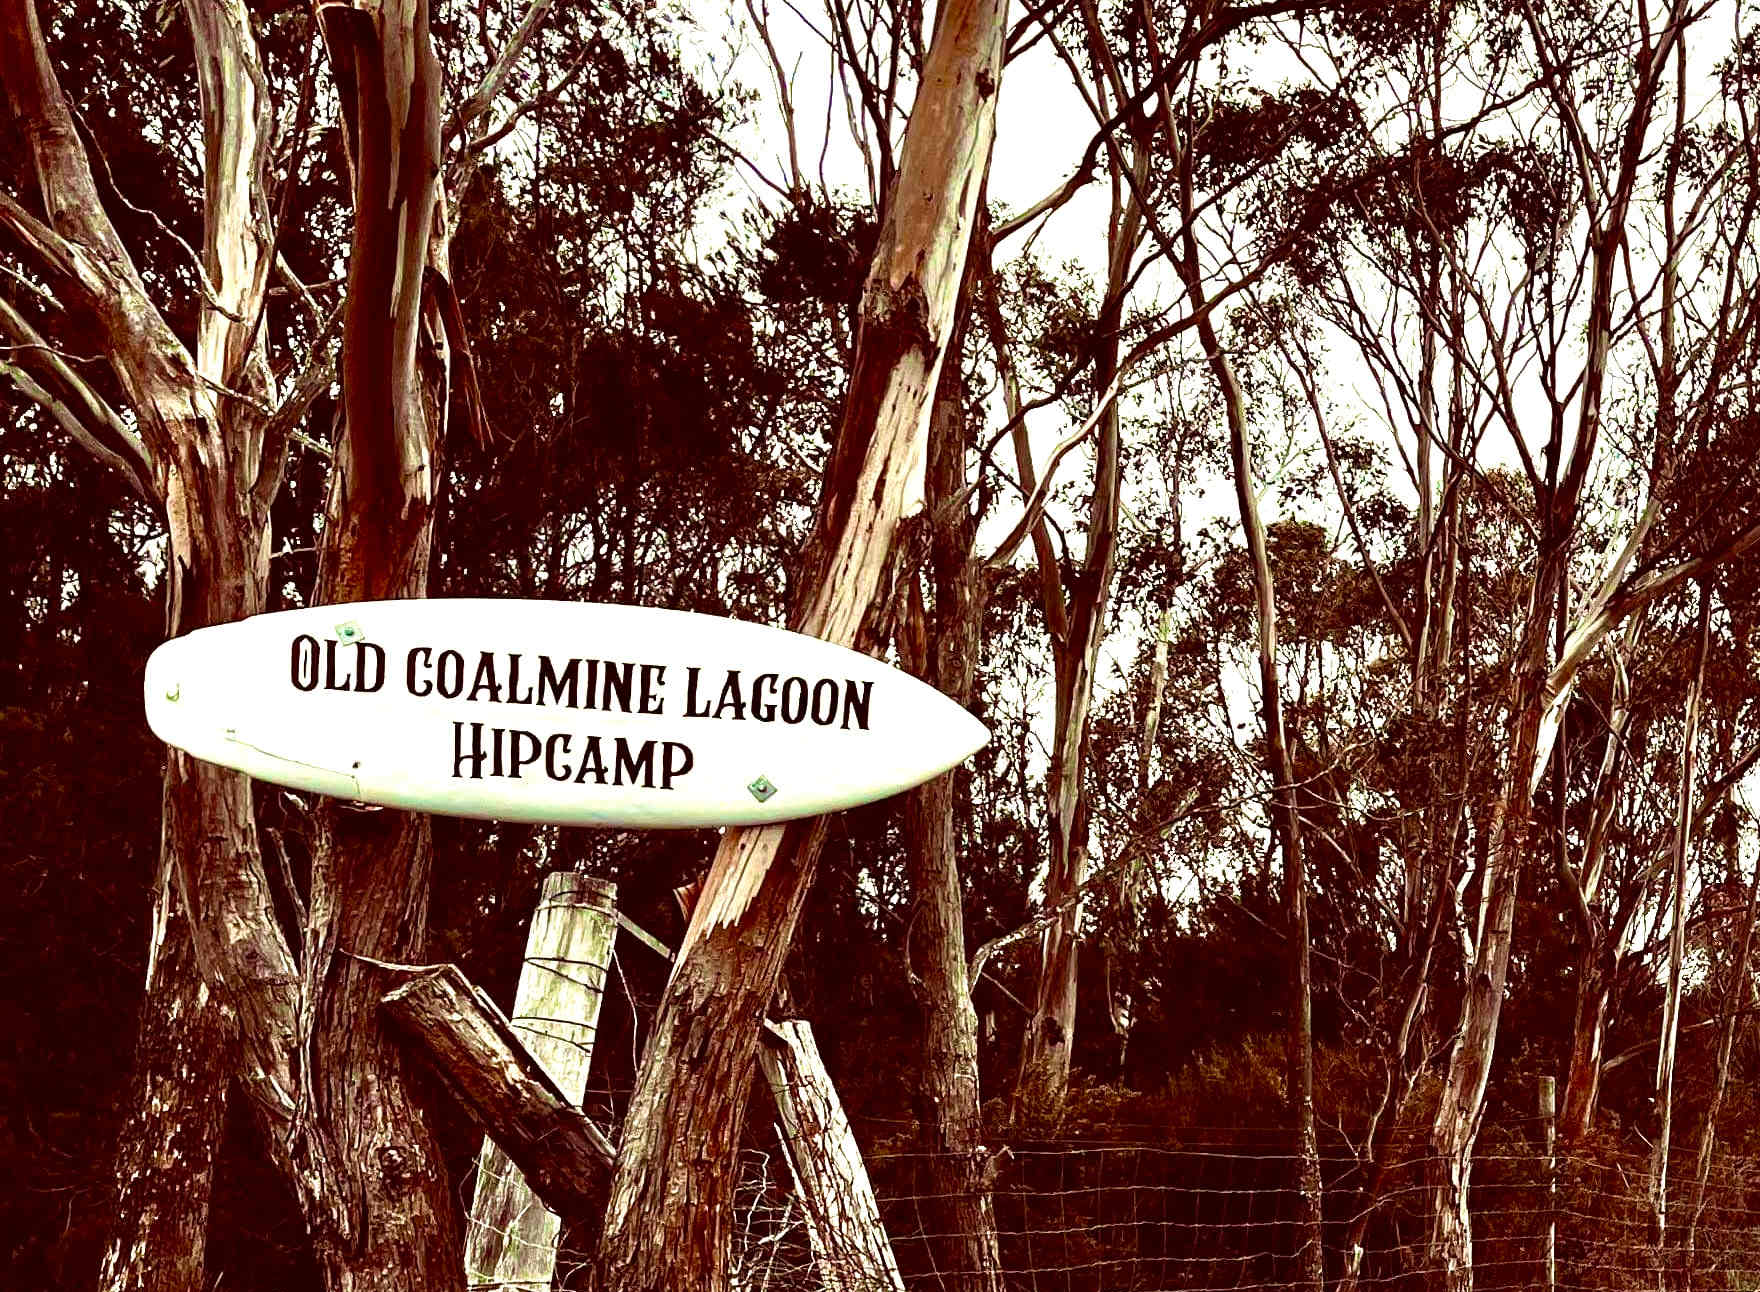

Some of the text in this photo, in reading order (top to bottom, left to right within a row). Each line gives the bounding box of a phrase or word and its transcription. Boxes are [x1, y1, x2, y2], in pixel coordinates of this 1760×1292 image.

[290, 634, 875, 731] OLD COALMINE LAGOON
[451, 721, 694, 791] HIPCAMP
